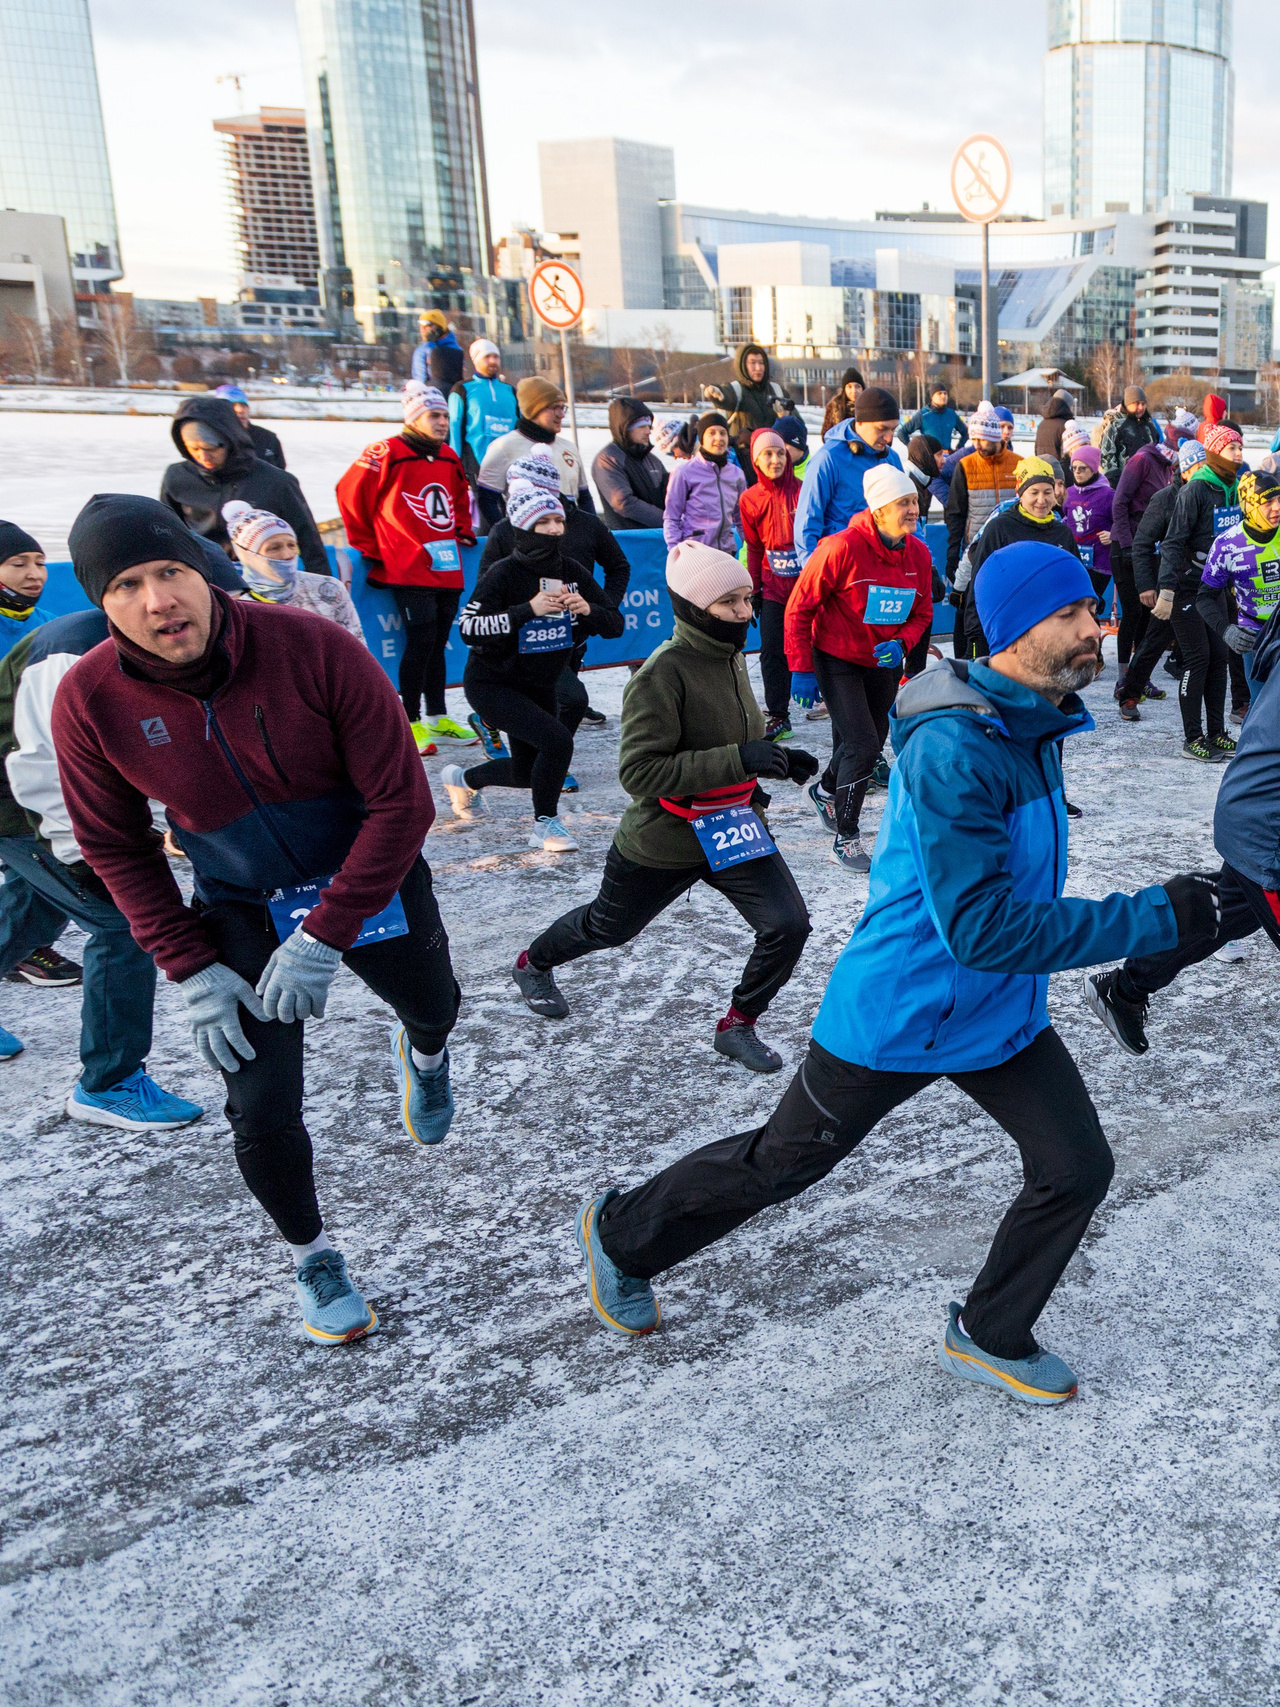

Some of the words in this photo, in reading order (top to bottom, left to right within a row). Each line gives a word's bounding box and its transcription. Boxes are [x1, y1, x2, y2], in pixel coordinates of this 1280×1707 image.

[1217, 514, 1240, 528] 2889
[880, 600, 903, 613] 123
[525, 625, 567, 642] 2882
[712, 822, 761, 851] 2201
[302, 884, 317, 892] KM
